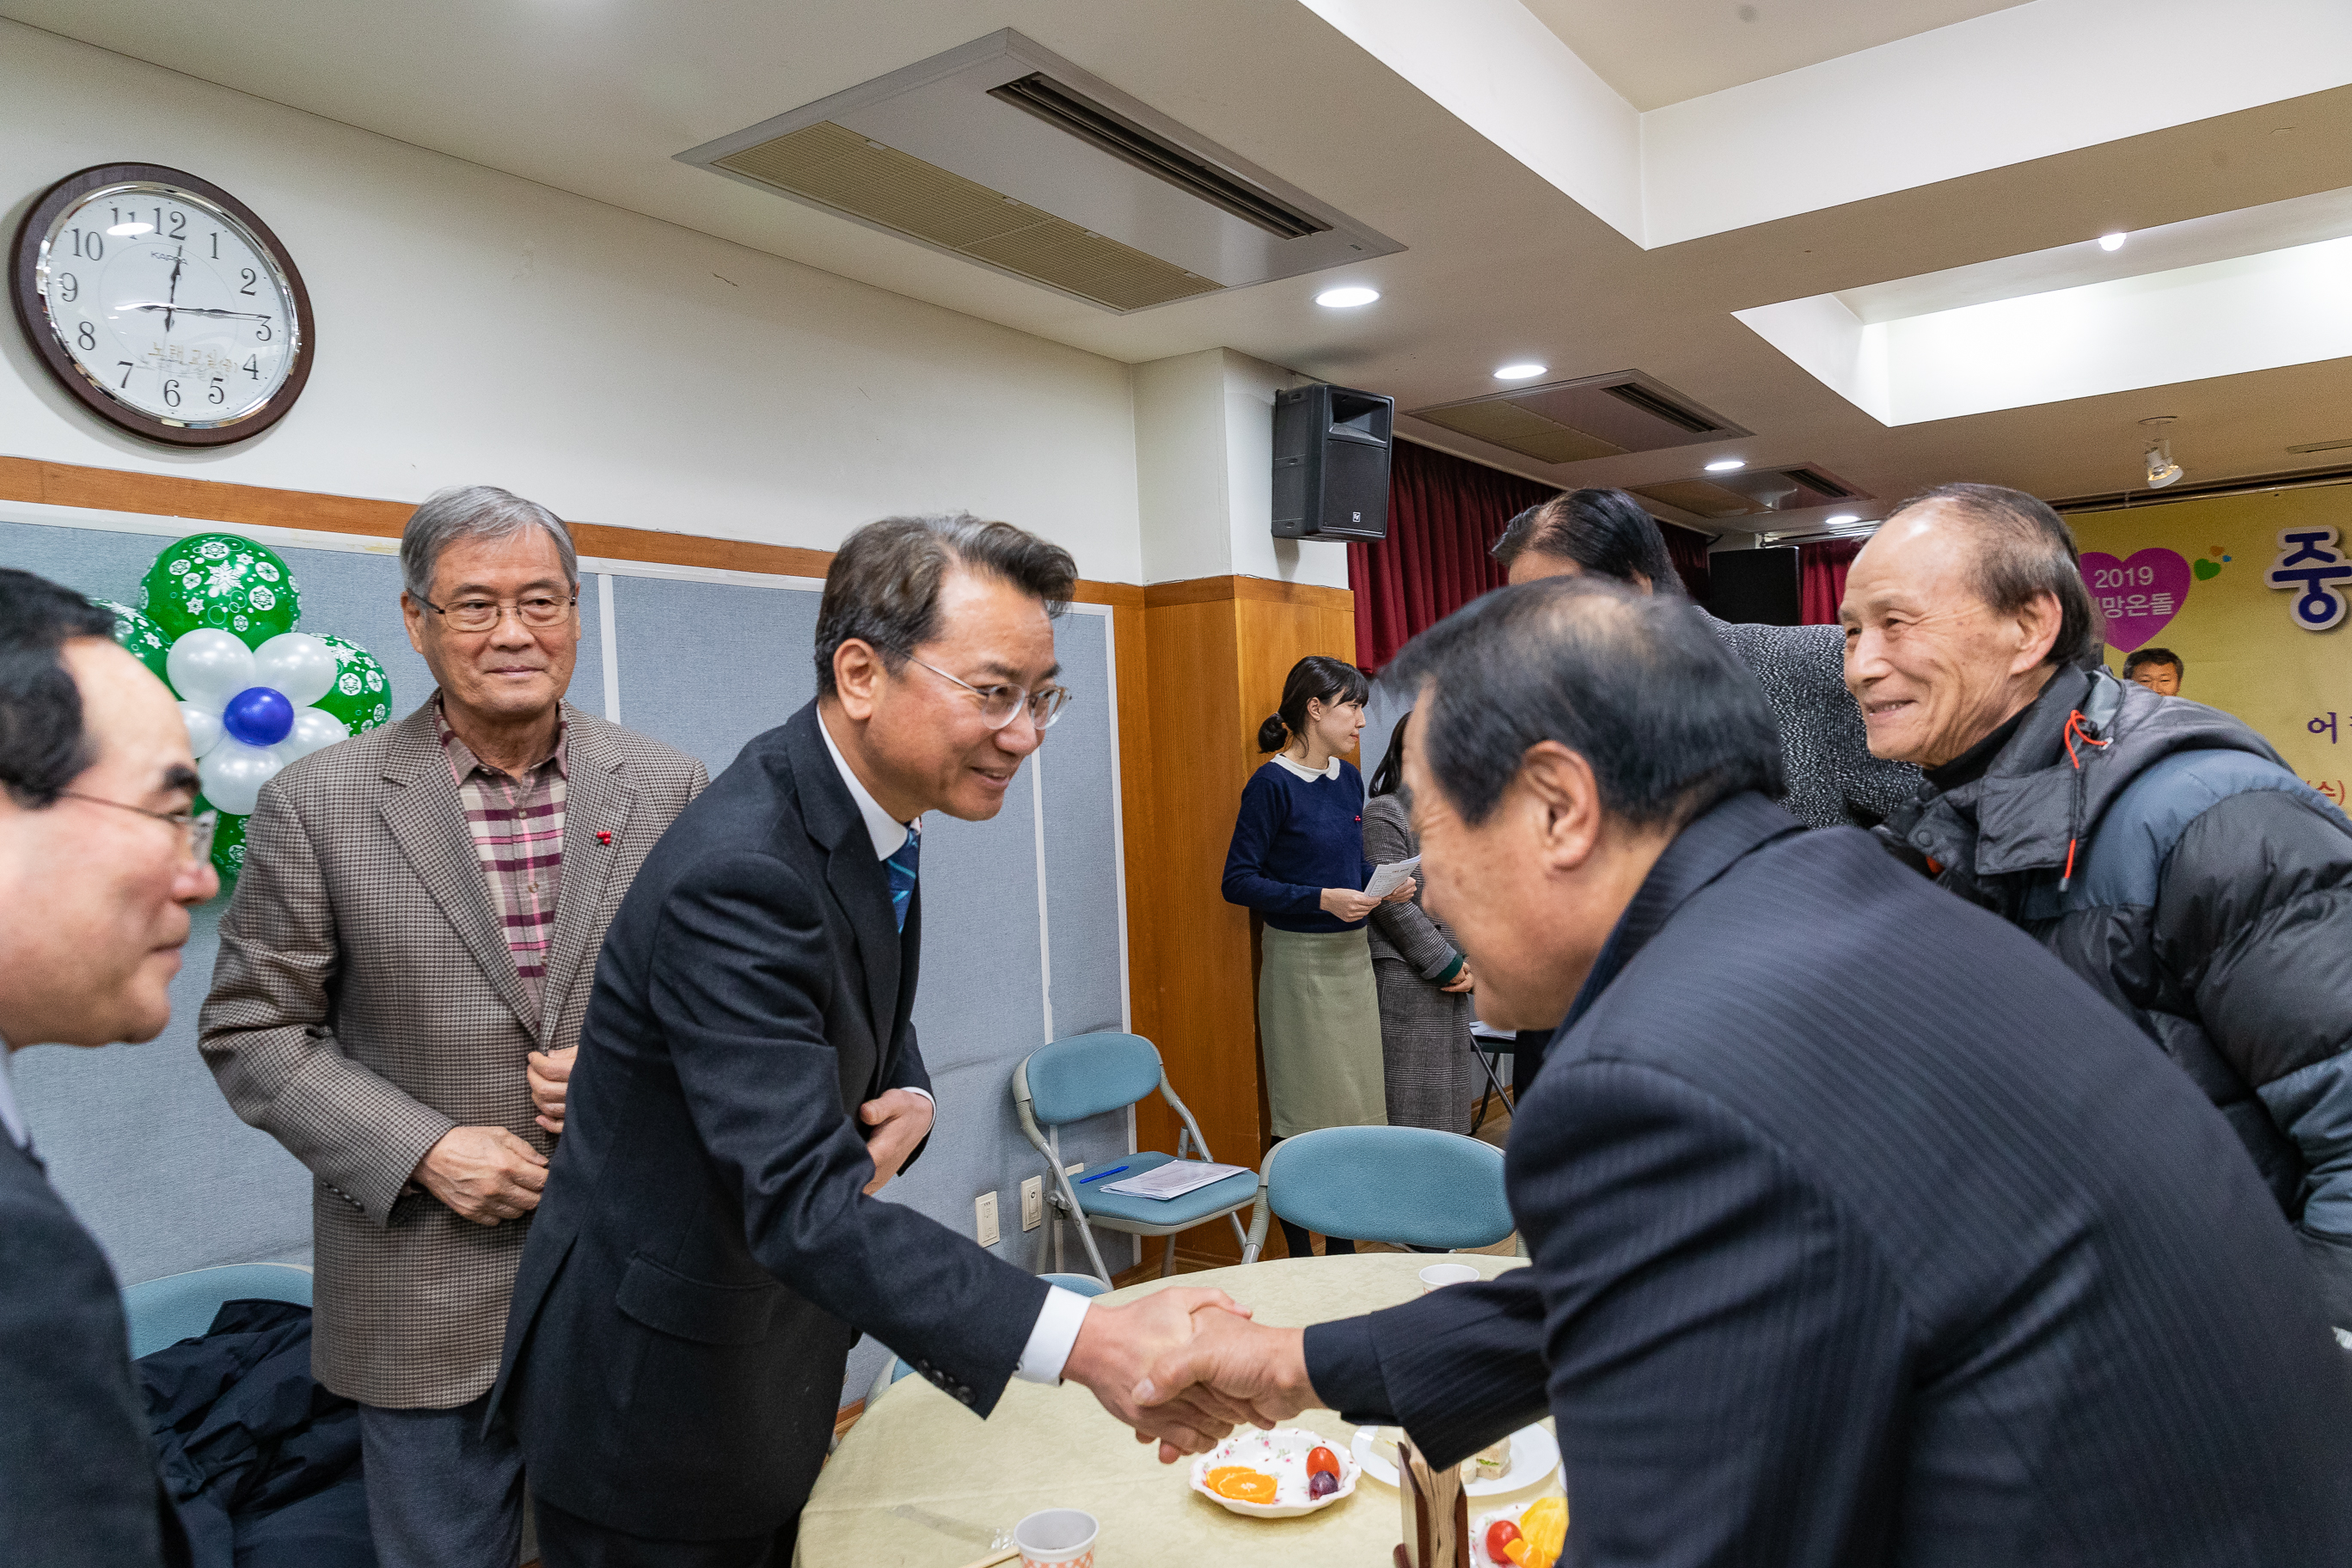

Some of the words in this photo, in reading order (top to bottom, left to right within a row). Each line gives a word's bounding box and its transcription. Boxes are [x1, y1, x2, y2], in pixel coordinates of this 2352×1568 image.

[154, 207, 187, 241] 12
[71, 228, 103, 261] 10
[210, 232, 220, 260] 1
[60, 273, 79, 302] 9
[240, 267, 257, 296] 2
[77, 322, 95, 351] 8
[256, 315, 272, 341] 3
[116, 360, 133, 389] 7
[242, 353, 259, 380] 4
[163, 379, 181, 407] 6
[208, 377, 224, 404] 5
[2094, 566, 2153, 588] 2019
[2272, 531, 2352, 623] 중
[2096, 592, 2175, 618] 망온돌
[2307, 712, 2352, 744] 어
